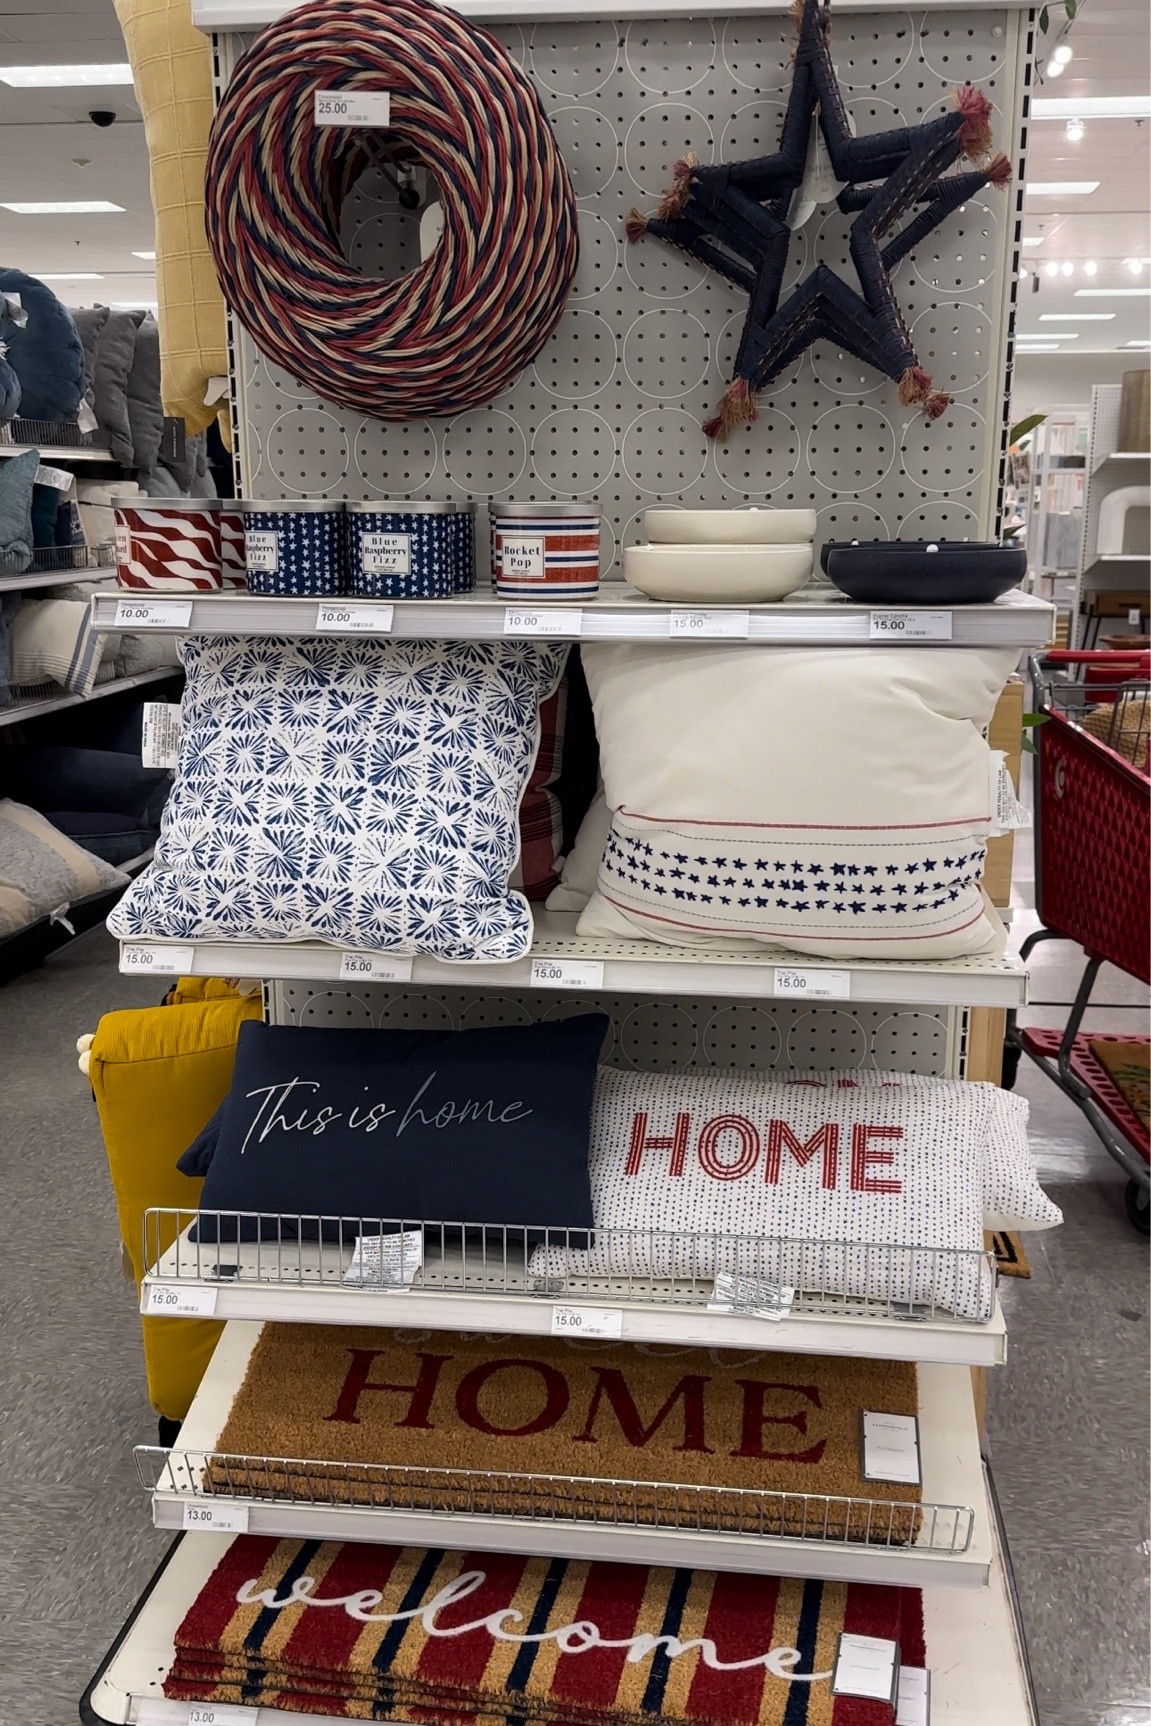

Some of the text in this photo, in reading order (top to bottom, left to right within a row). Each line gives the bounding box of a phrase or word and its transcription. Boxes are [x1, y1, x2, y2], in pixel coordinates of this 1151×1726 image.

[318, 102, 348, 114] 25.00
[249, 535, 267, 543] Blue
[371, 537, 398, 546] Blue
[364, 546, 407, 557] Raspberry
[504, 545, 540, 556] Rocket
[372, 555, 397, 564] Fizz
[510, 557, 532, 569] Pop
[120, 609, 149, 618] 10.00
[321, 612, 351, 622] 10.00
[508, 616, 538, 626] 10.00
[873, 620, 905, 630] 15.00
[126, 954, 153, 964] 15.00
[345, 961, 372, 971] 15.00
[534, 968, 562, 978] 15.00
[777, 978, 807, 988] 15.00
[241, 1070, 534, 1154] This is home
[624, 1111, 904, 1194] HOME
[152, 1294, 178, 1304] 15.00
[555, 1315, 582, 1326] 15.00
[322, 1348, 828, 1464] HOME
[187, 1510, 213, 1521] 13.00
[235, 1570, 833, 1682] welcome
[190, 1711, 215, 1723] 13.00
